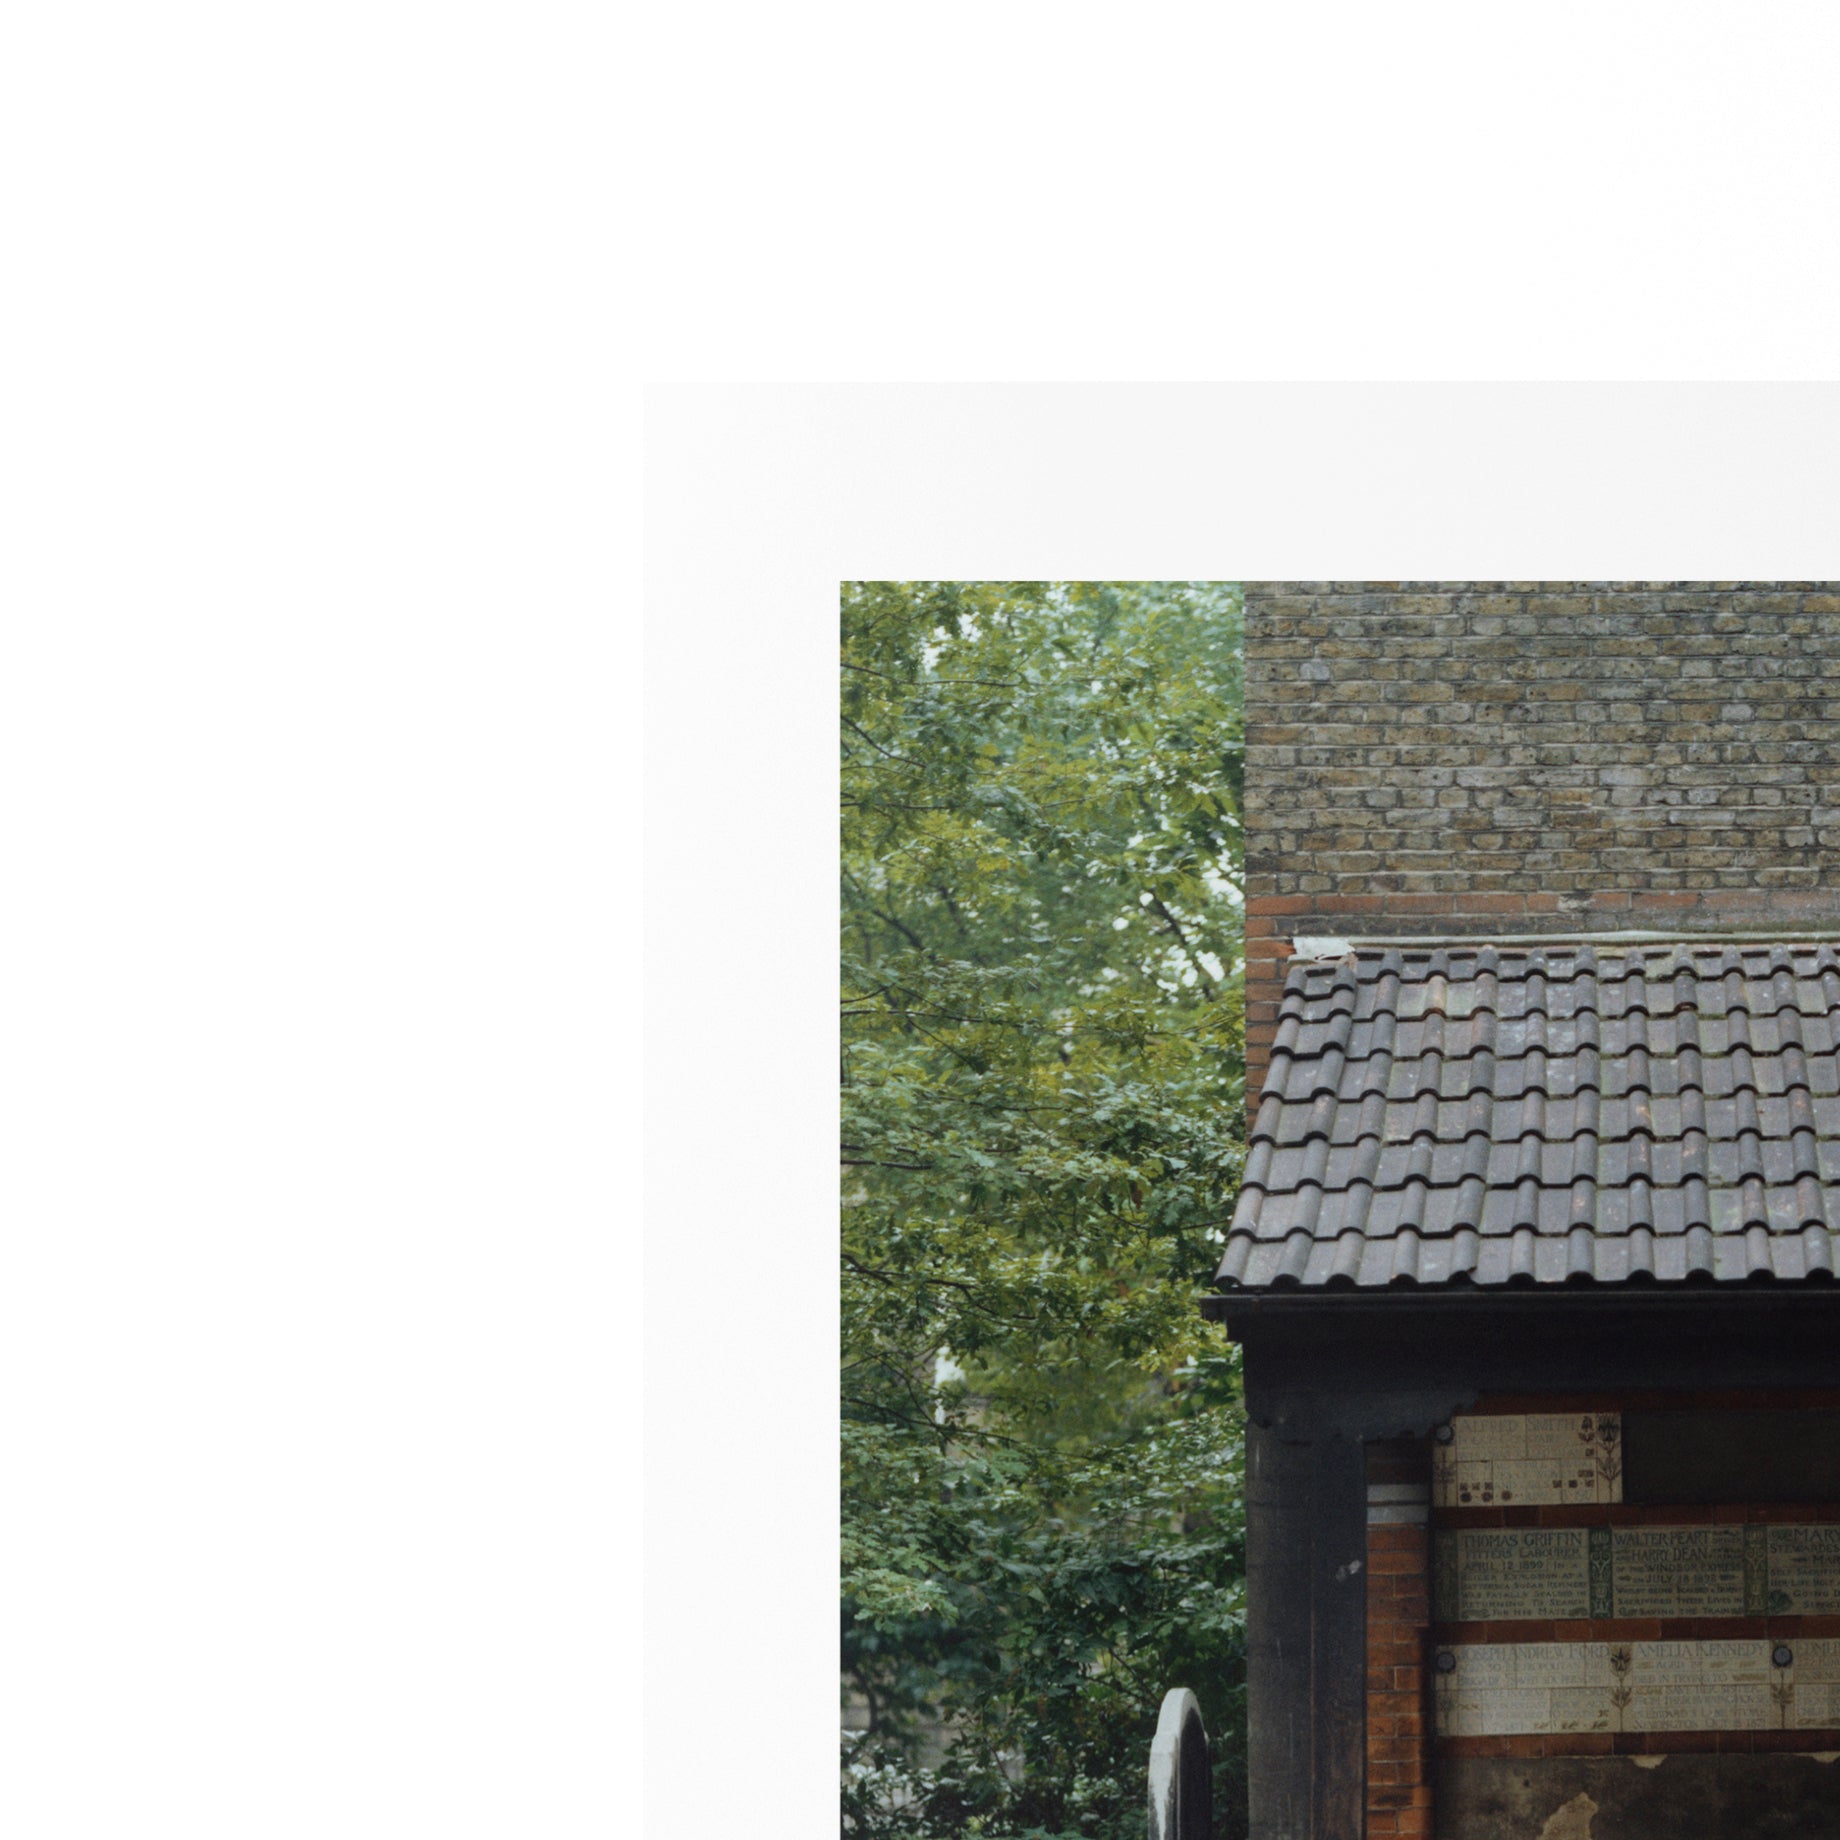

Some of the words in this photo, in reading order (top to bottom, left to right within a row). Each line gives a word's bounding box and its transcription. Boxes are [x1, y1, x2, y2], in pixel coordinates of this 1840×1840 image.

[1464, 1534, 1518, 1548] THOMAS
[1524, 1532, 1582, 1546] GRIFFIN
[1614, 1532, 1669, 1545] WALTER
[1670, 1531, 1708, 1544] PEART
[1632, 1549, 1669, 1561] HARRY
[1673, 1548, 1708, 1561] DEAN
[1646, 1574, 1673, 1584] JULY
[1636, 1643, 1693, 1657] AMELIA
[1696, 1642, 1763, 1657] KENNEDY
